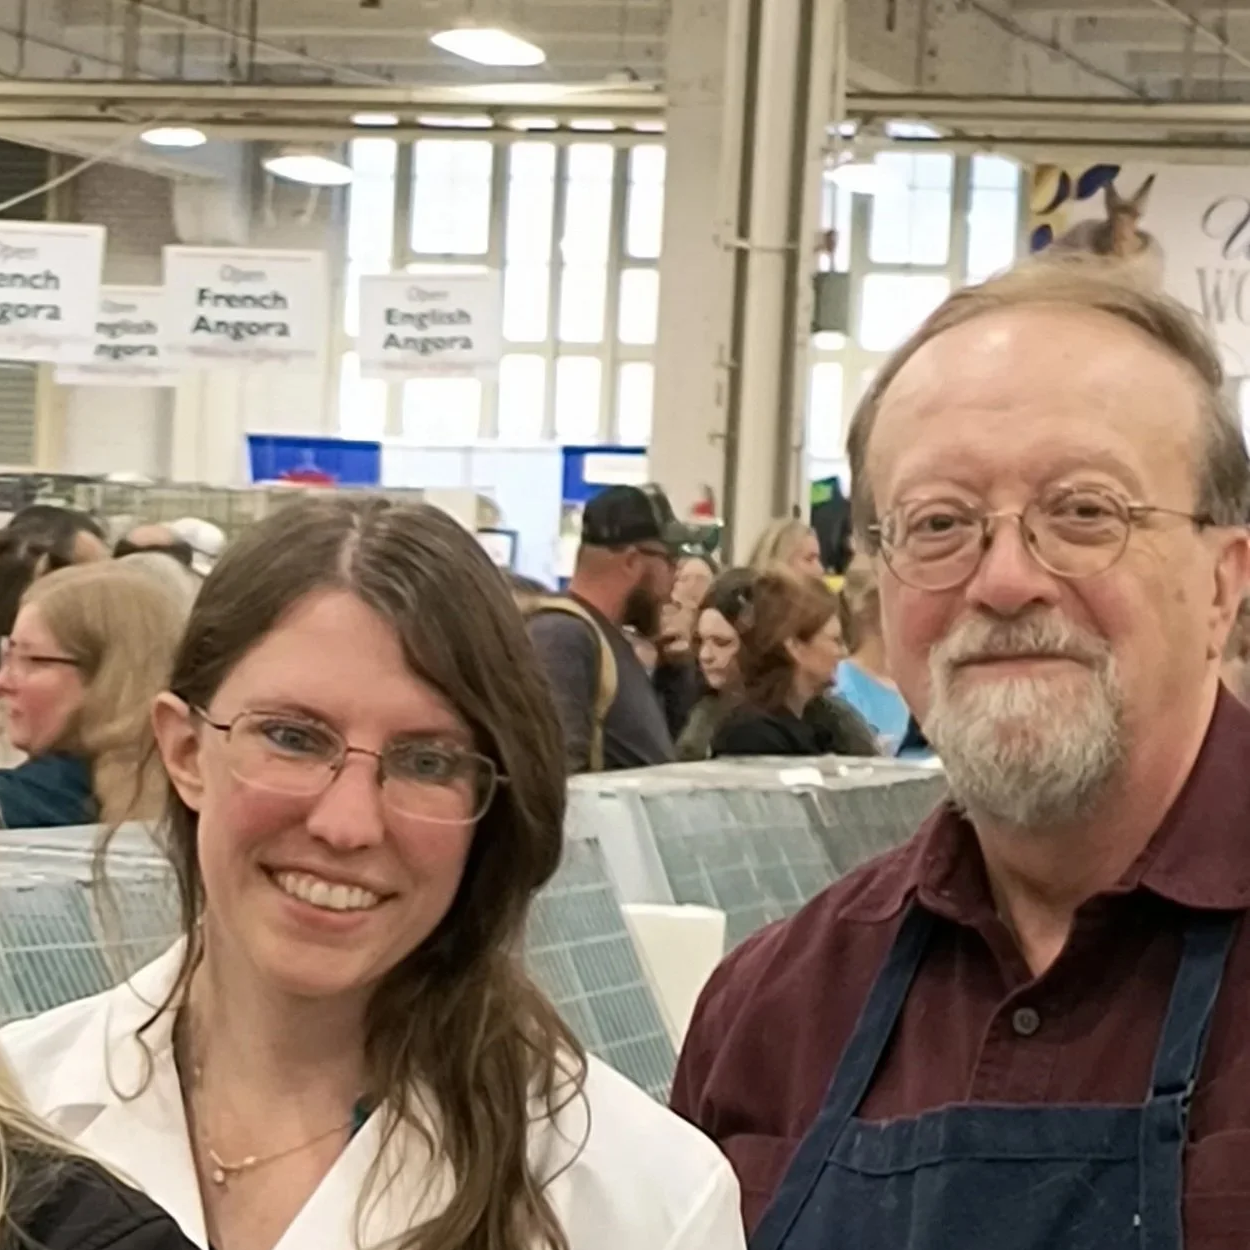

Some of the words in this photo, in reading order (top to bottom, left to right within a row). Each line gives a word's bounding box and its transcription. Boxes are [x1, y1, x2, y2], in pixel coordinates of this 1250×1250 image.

[219, 263, 267, 285] Open
[196, 287, 288, 309] French
[95, 319, 158, 339] nglish
[191, 315, 290, 341] Angora
[384, 307, 471, 331] English
[94, 343, 158, 360] ngora
[382, 333, 473, 356] Angora
